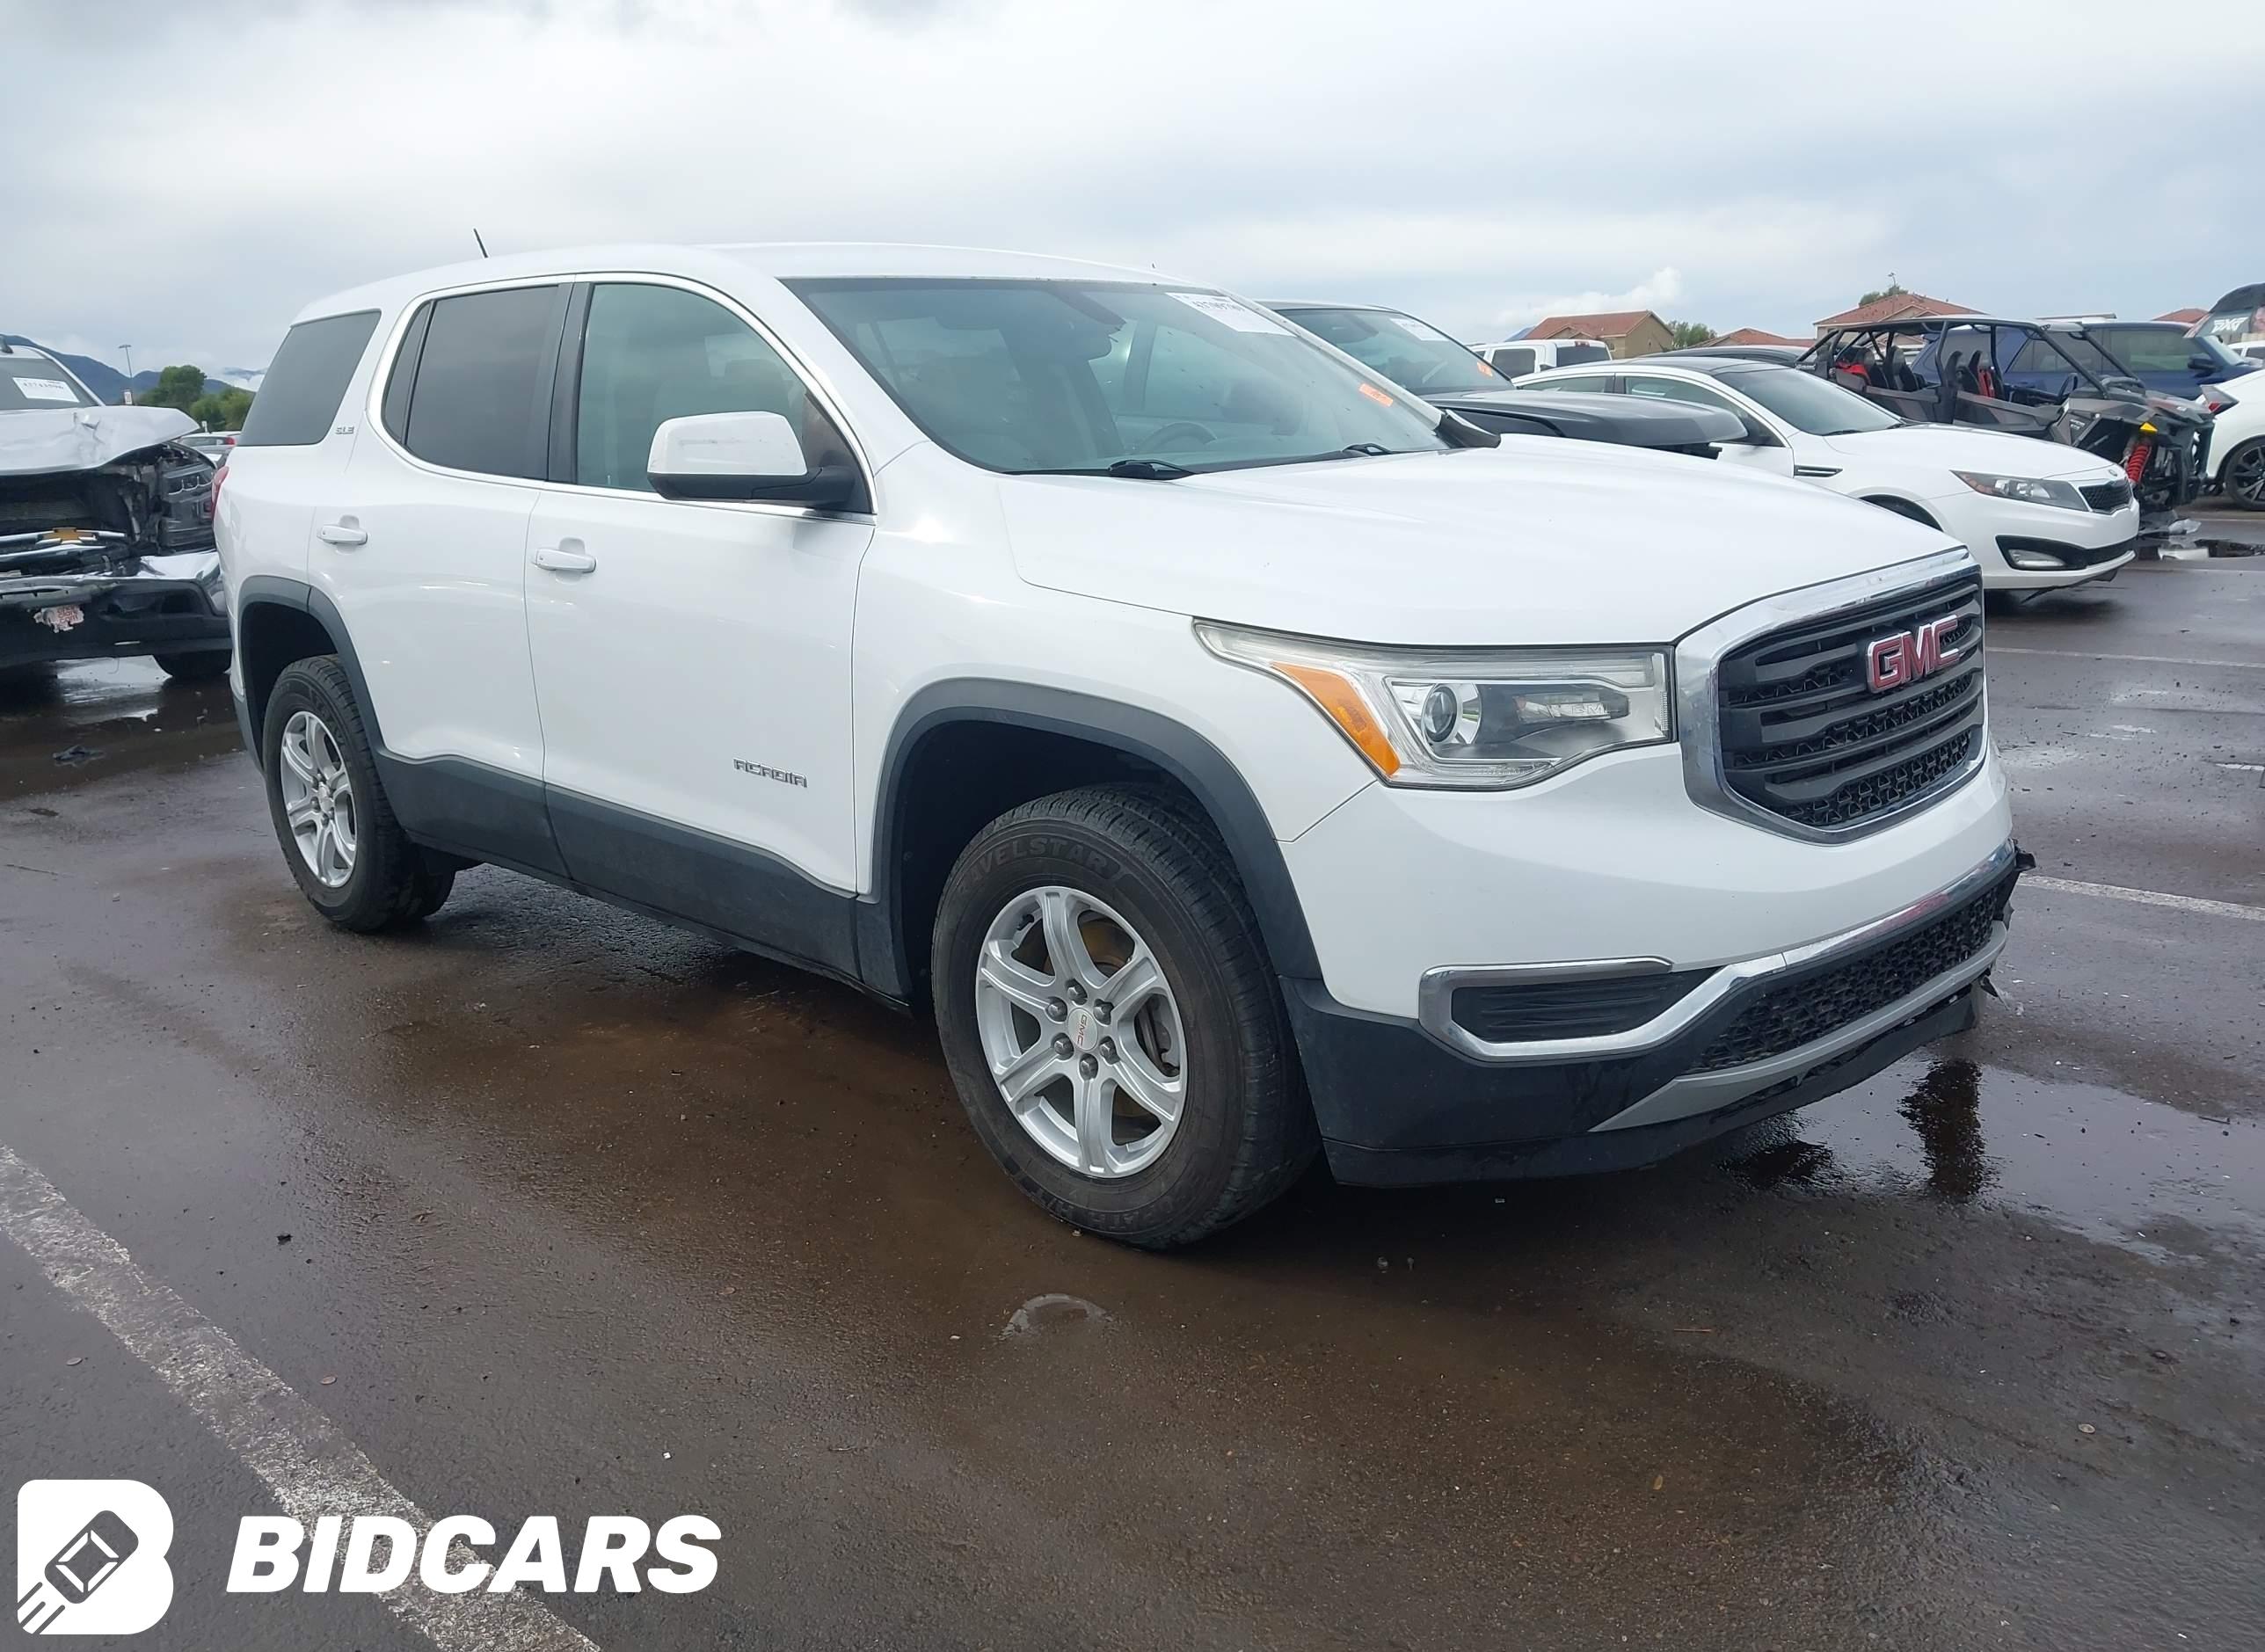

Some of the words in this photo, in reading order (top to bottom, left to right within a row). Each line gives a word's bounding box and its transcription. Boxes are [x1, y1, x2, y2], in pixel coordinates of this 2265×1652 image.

[335, 426, 354, 435] SLE
[1867, 615, 1960, 694] GMC
[732, 757, 808, 788] ACADIA
[1077, 1014, 1088, 1046] GMC
